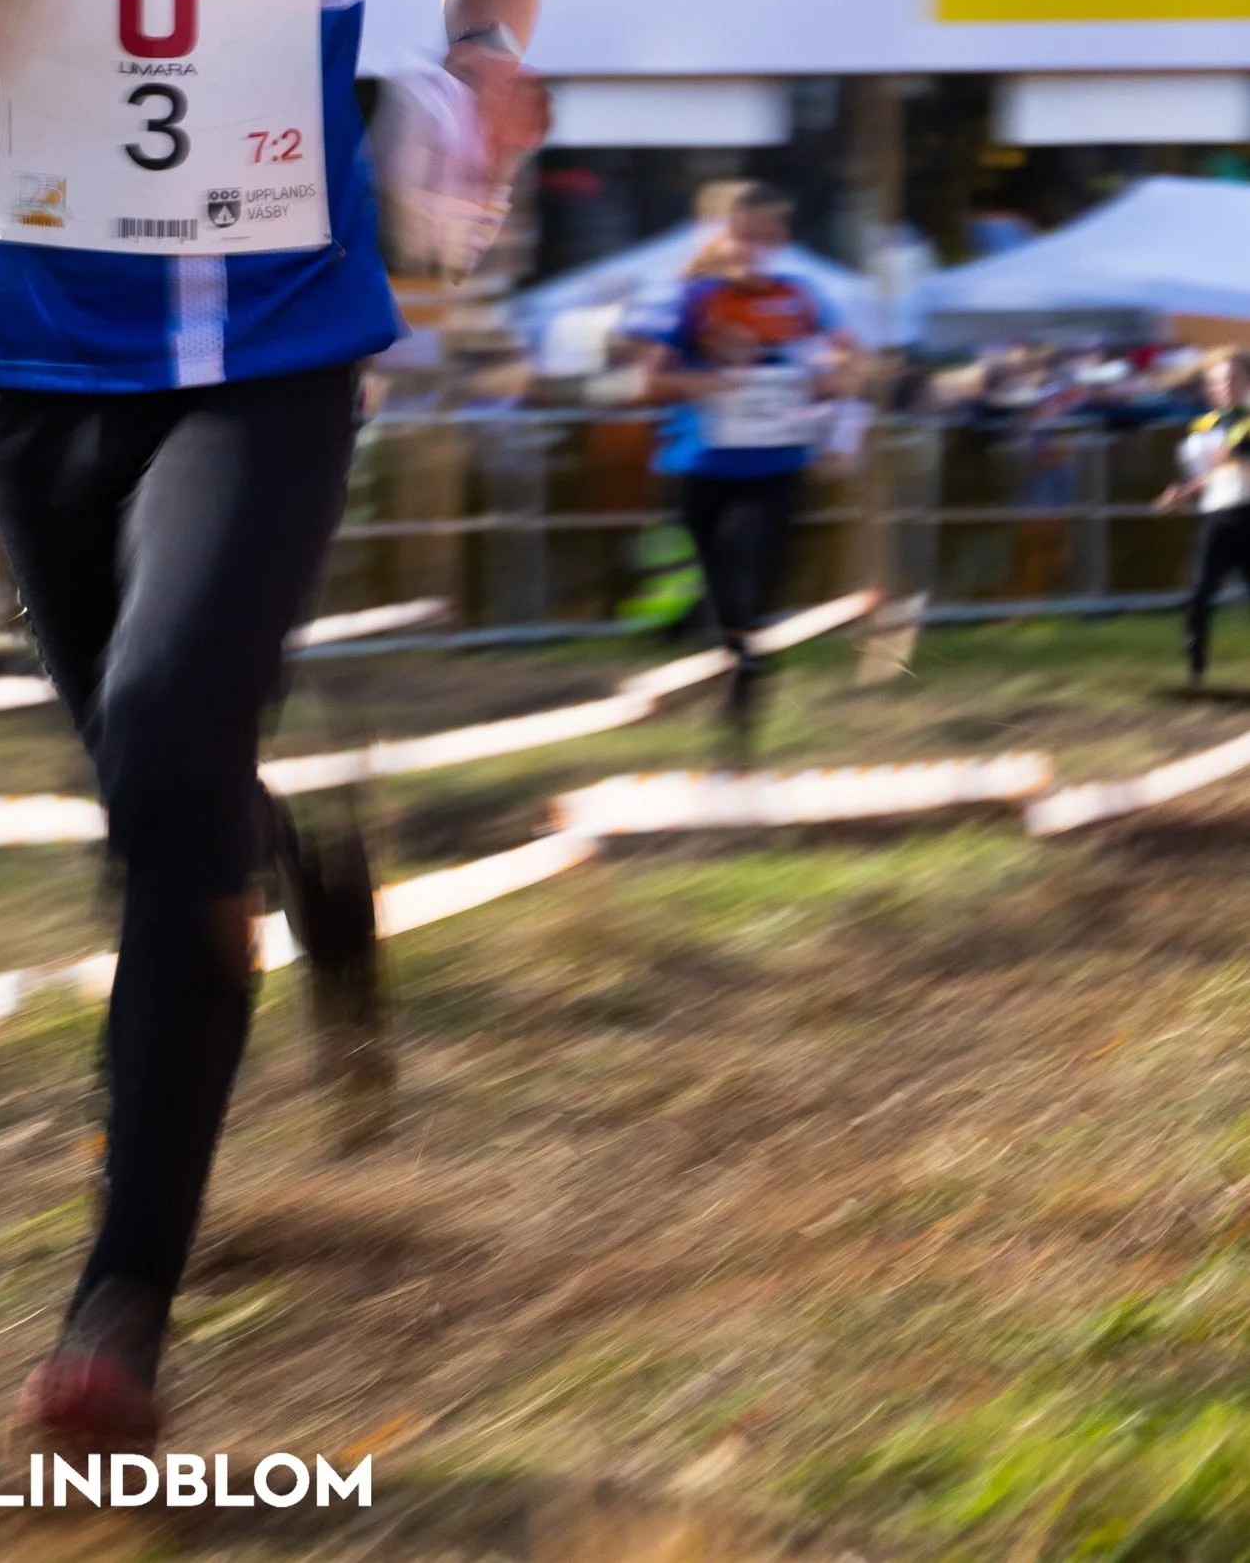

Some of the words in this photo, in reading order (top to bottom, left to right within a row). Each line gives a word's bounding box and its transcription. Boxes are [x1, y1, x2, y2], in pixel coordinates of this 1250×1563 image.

[118, 61, 199, 77] UMARA
[124, 82, 192, 171] 3
[246, 128, 303, 164] 7:2
[246, 184, 317, 202] UPPLANDS
